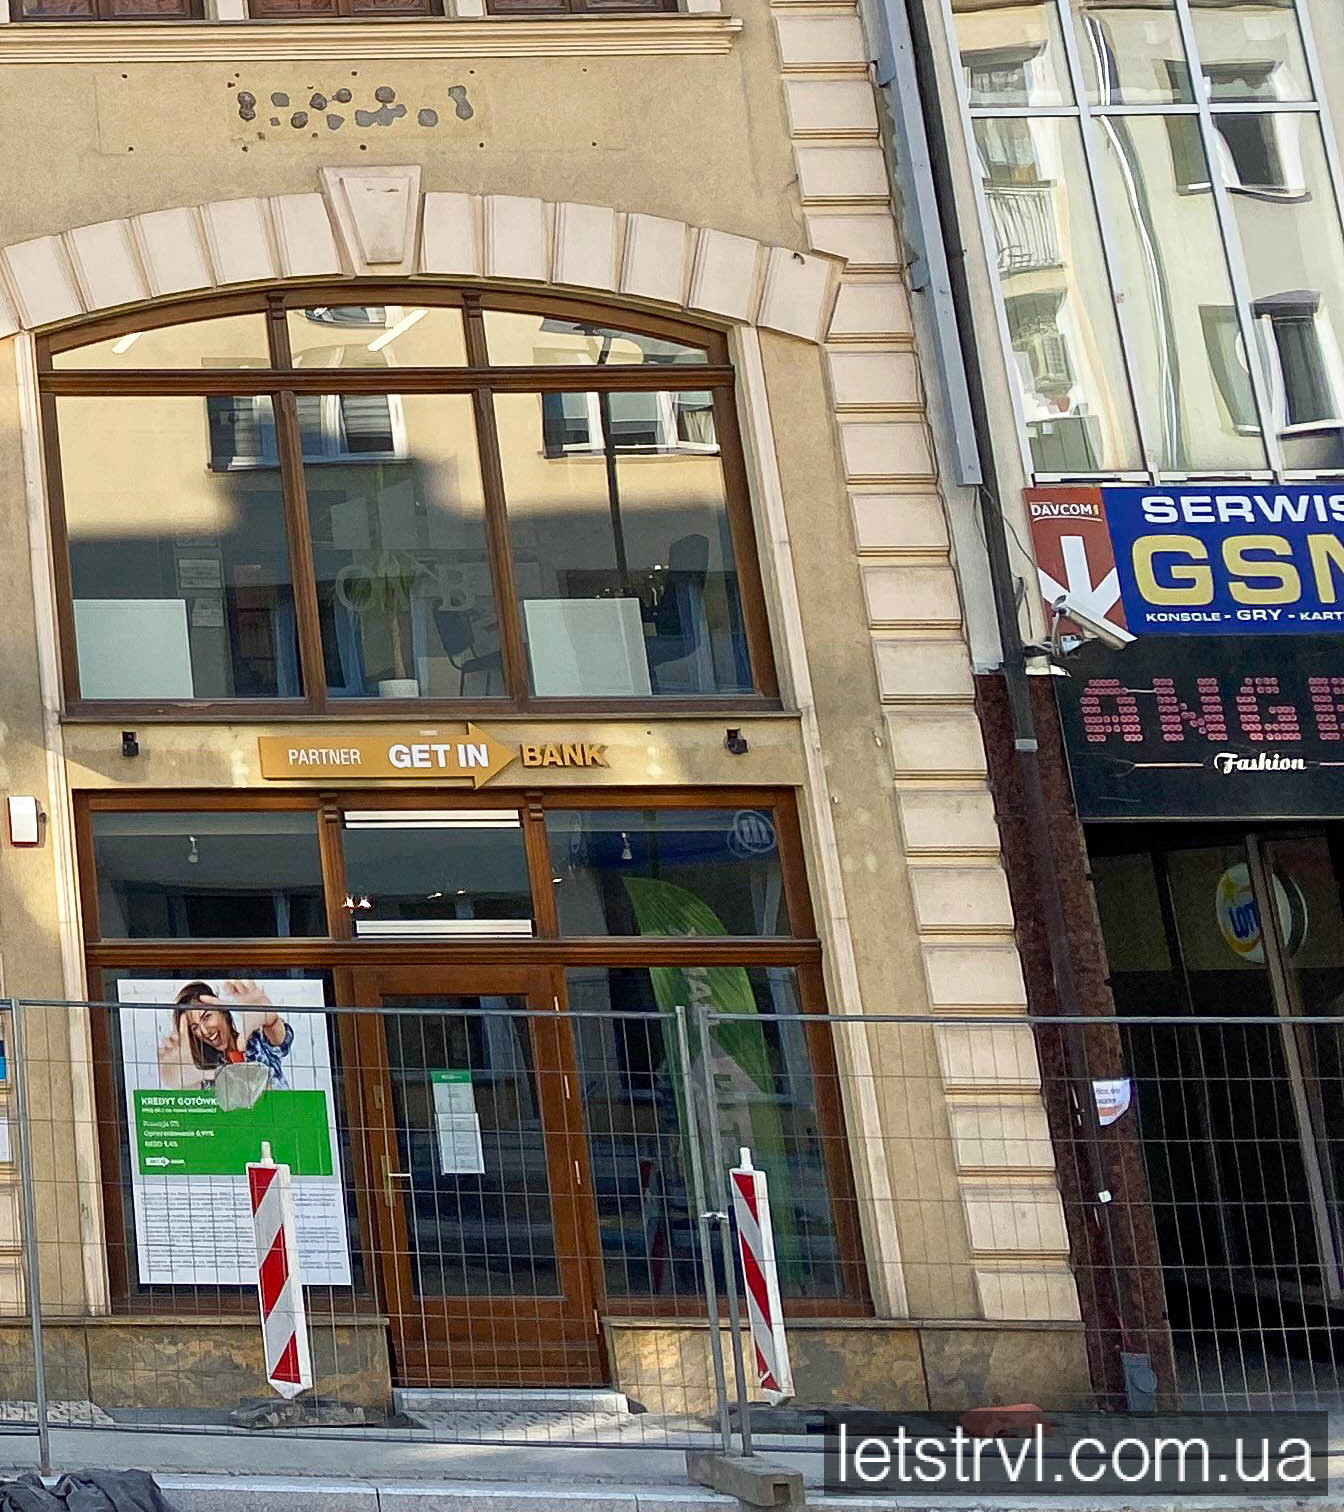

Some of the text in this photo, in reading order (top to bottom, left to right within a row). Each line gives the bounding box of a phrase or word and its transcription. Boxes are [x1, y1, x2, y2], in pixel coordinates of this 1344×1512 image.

[1141, 495, 1344, 524] SERWI
[1145, 612, 1221, 623] KONSOLE
[1236, 609, 1282, 622] GRY
[288, 743, 609, 769] PARTNER GET IN BANK
[1213, 752, 1307, 775] Fashion
[141, 1095, 217, 1106] KREDYT GOTÓWK
